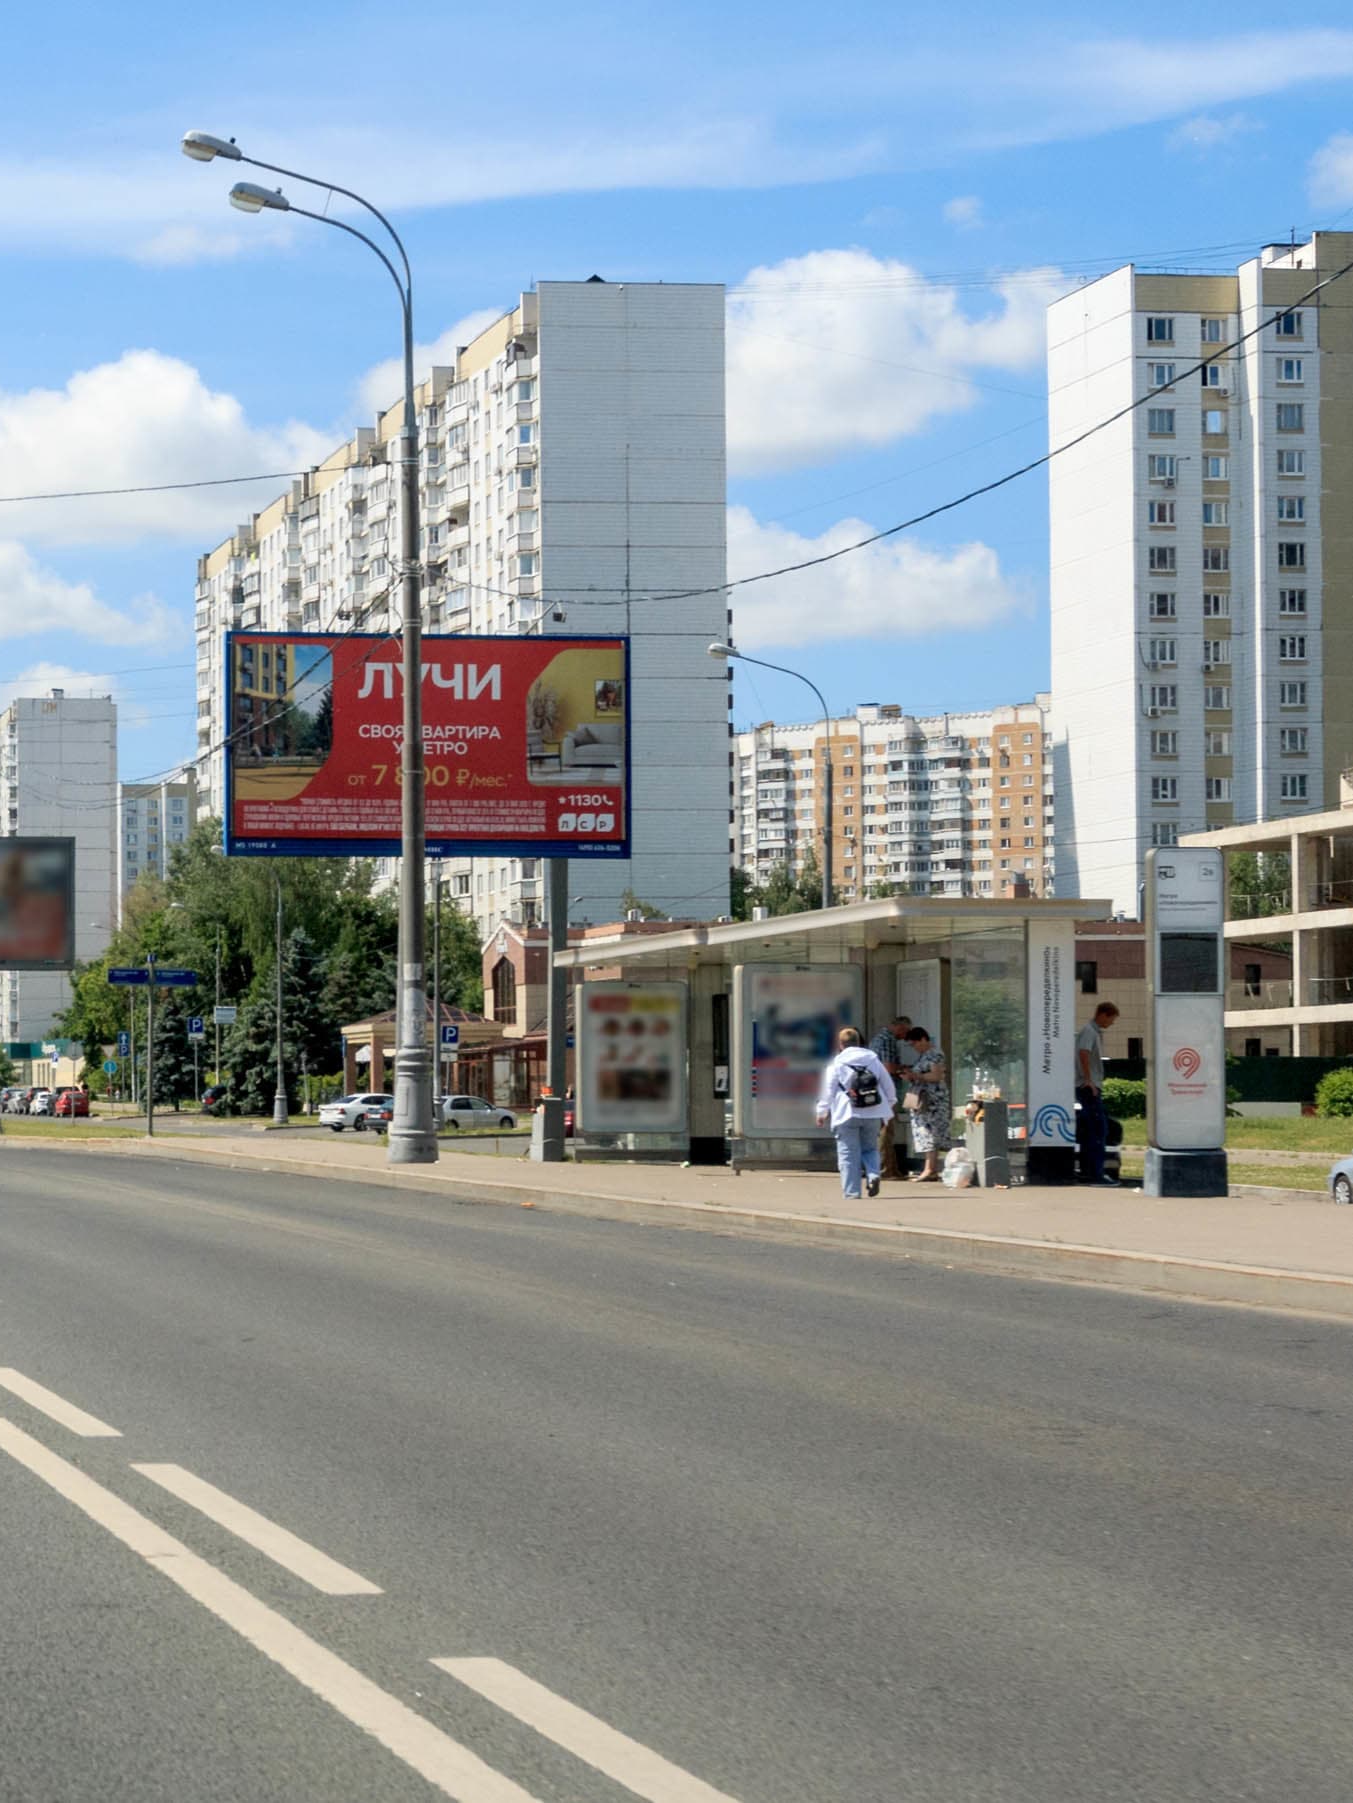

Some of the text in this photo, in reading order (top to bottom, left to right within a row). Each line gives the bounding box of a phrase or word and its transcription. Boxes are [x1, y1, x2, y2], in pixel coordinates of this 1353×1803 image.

[357, 662, 502, 701] ЛУЧИ
[358, 724, 502, 740] СВОЯ ВАРТИРА
[422, 741, 468, 756] ЕТРО
[348, 775, 367, 786] от
[371, 764, 389, 786] 7
[445, 1027, 457, 1042] P
[1042, 1042, 1052, 1074] Метро
